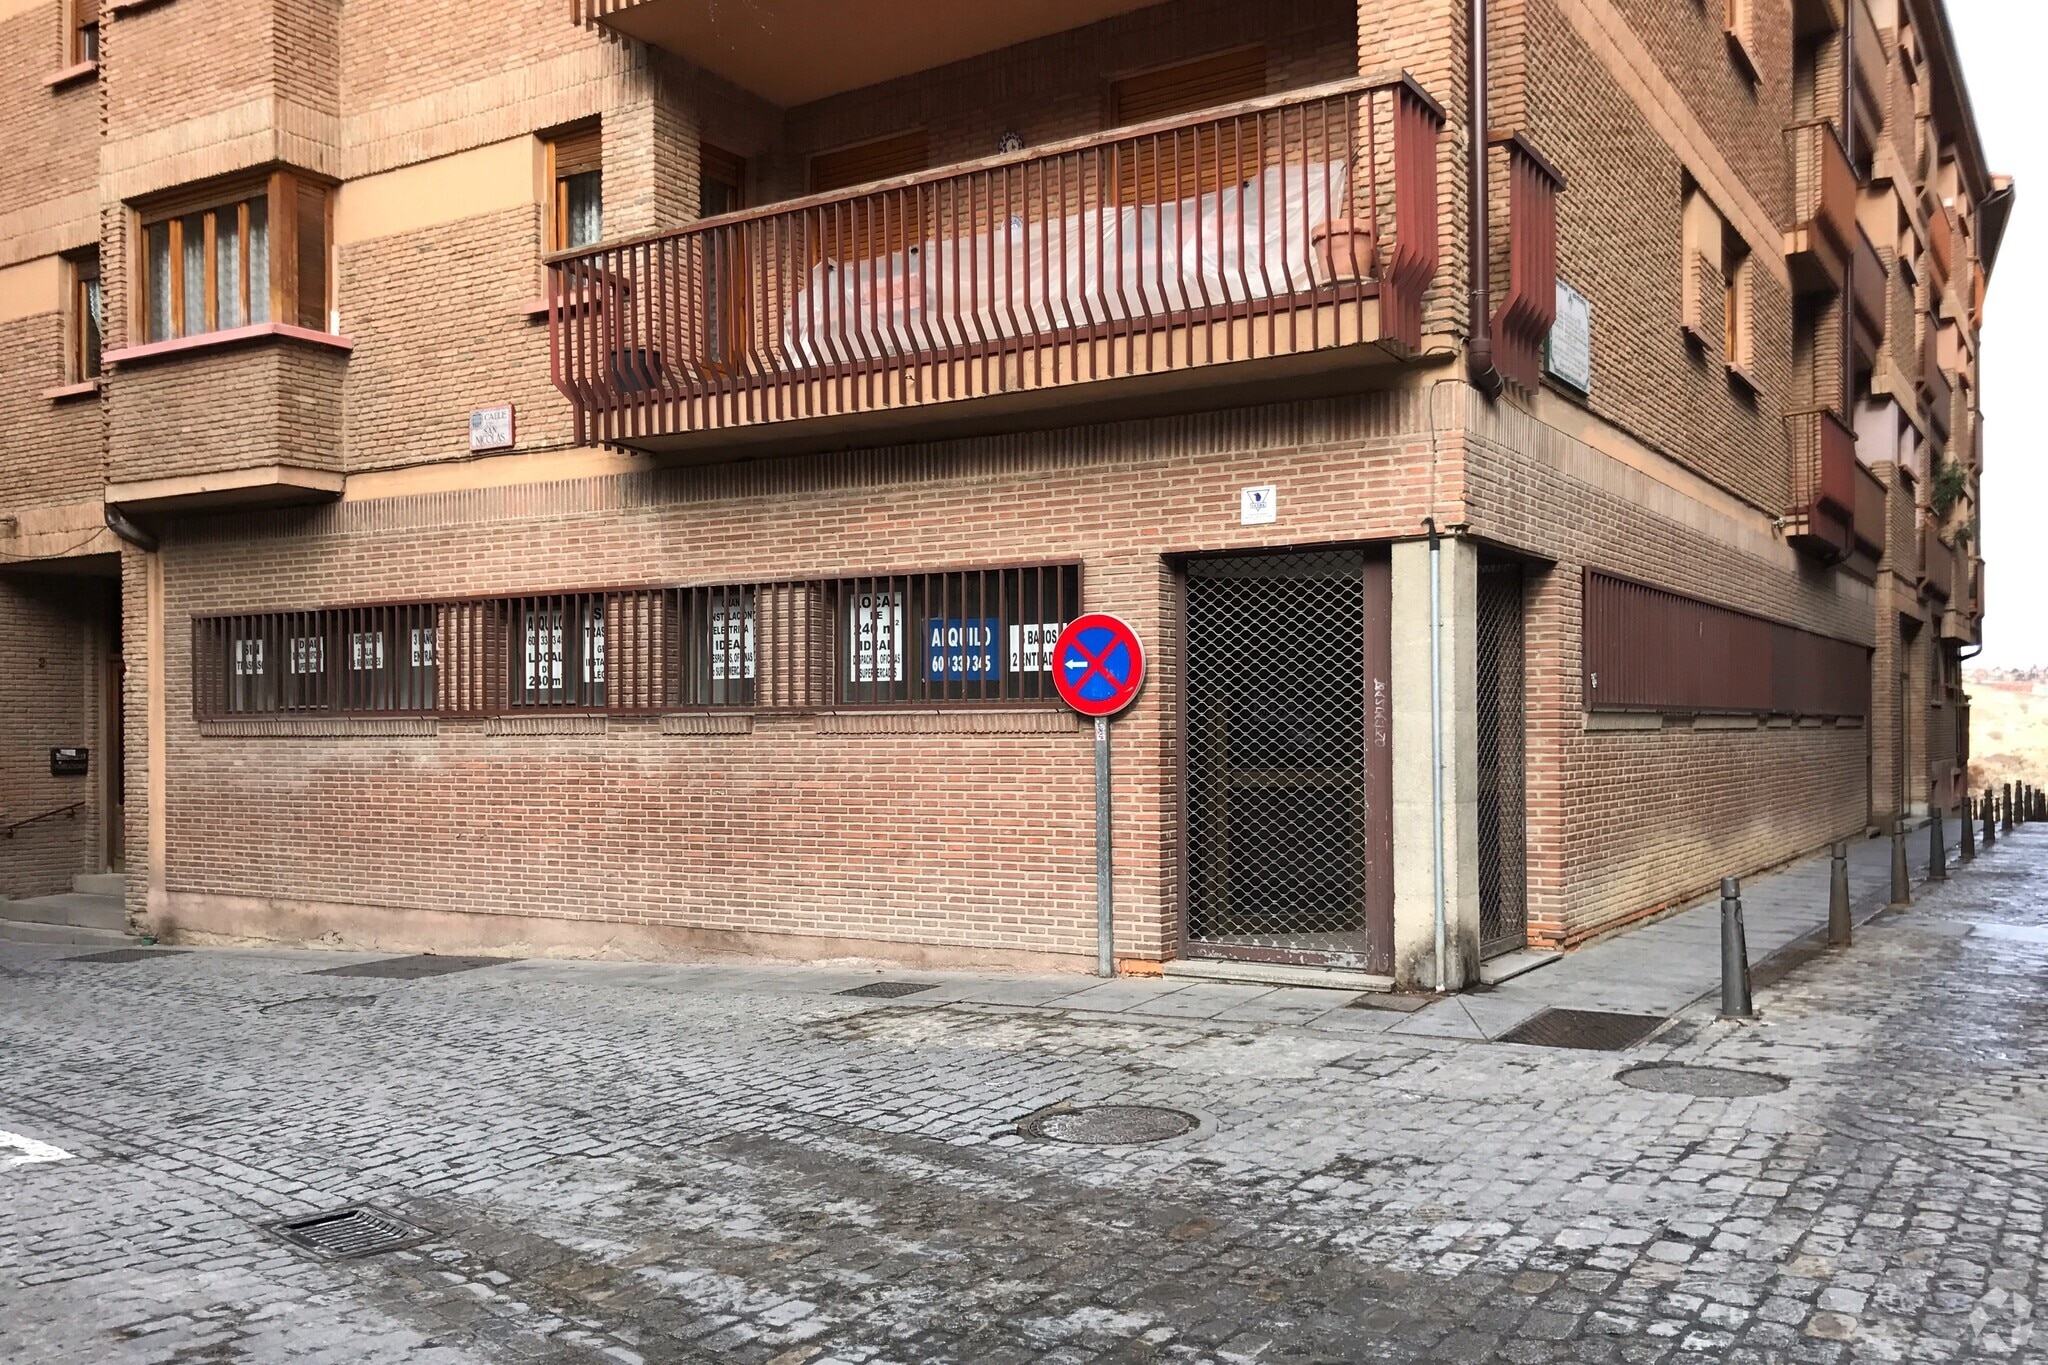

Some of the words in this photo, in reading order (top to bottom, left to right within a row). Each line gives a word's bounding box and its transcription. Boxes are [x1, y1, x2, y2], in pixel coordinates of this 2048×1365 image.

[484, 411, 507, 420] CALLE
[484, 426, 497, 434] SAN
[1012, 652, 1018, 667] 2
